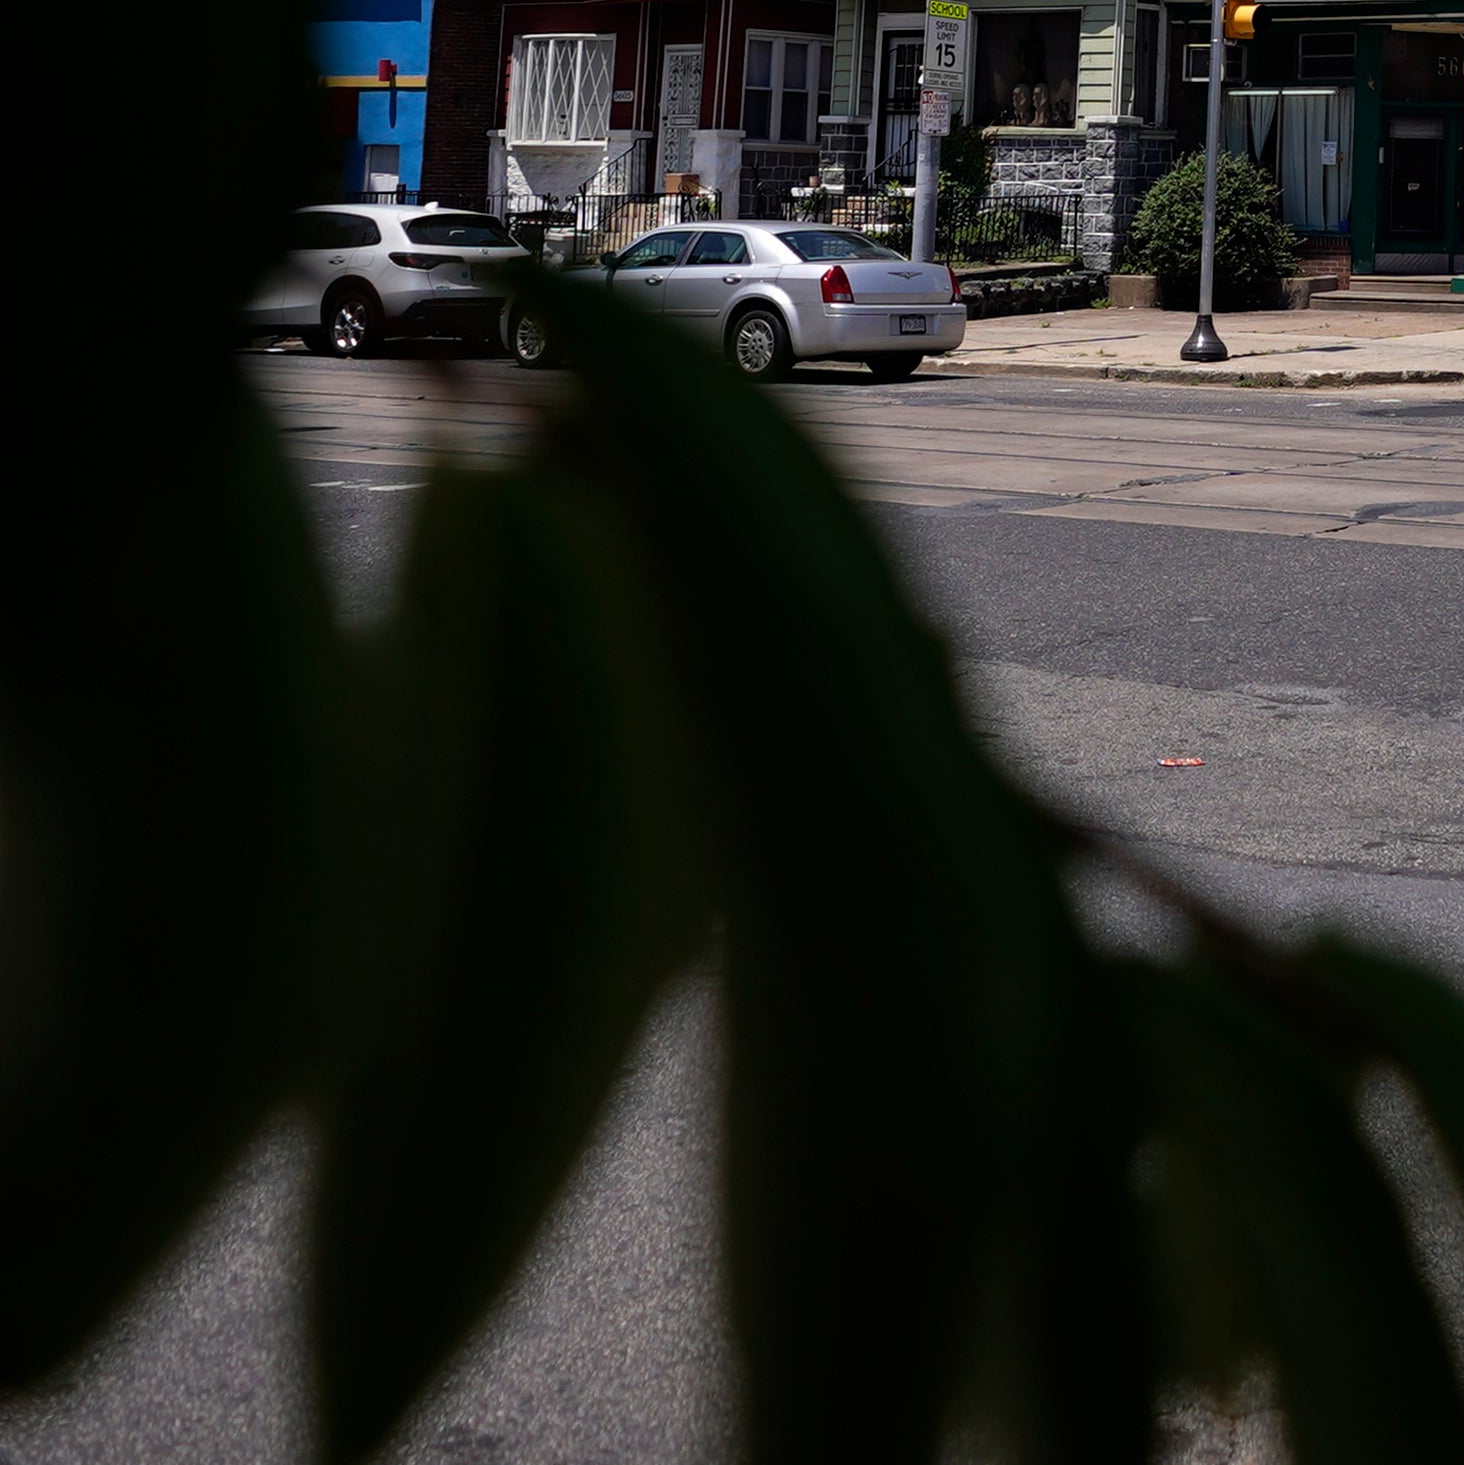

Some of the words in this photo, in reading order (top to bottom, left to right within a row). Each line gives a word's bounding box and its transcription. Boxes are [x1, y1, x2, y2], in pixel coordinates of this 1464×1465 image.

[930, 2, 966, 18] SCHOOL
[936, 21, 959, 32] SPEED
[937, 33, 956, 41] LIMIT
[936, 43, 955, 68] 15
